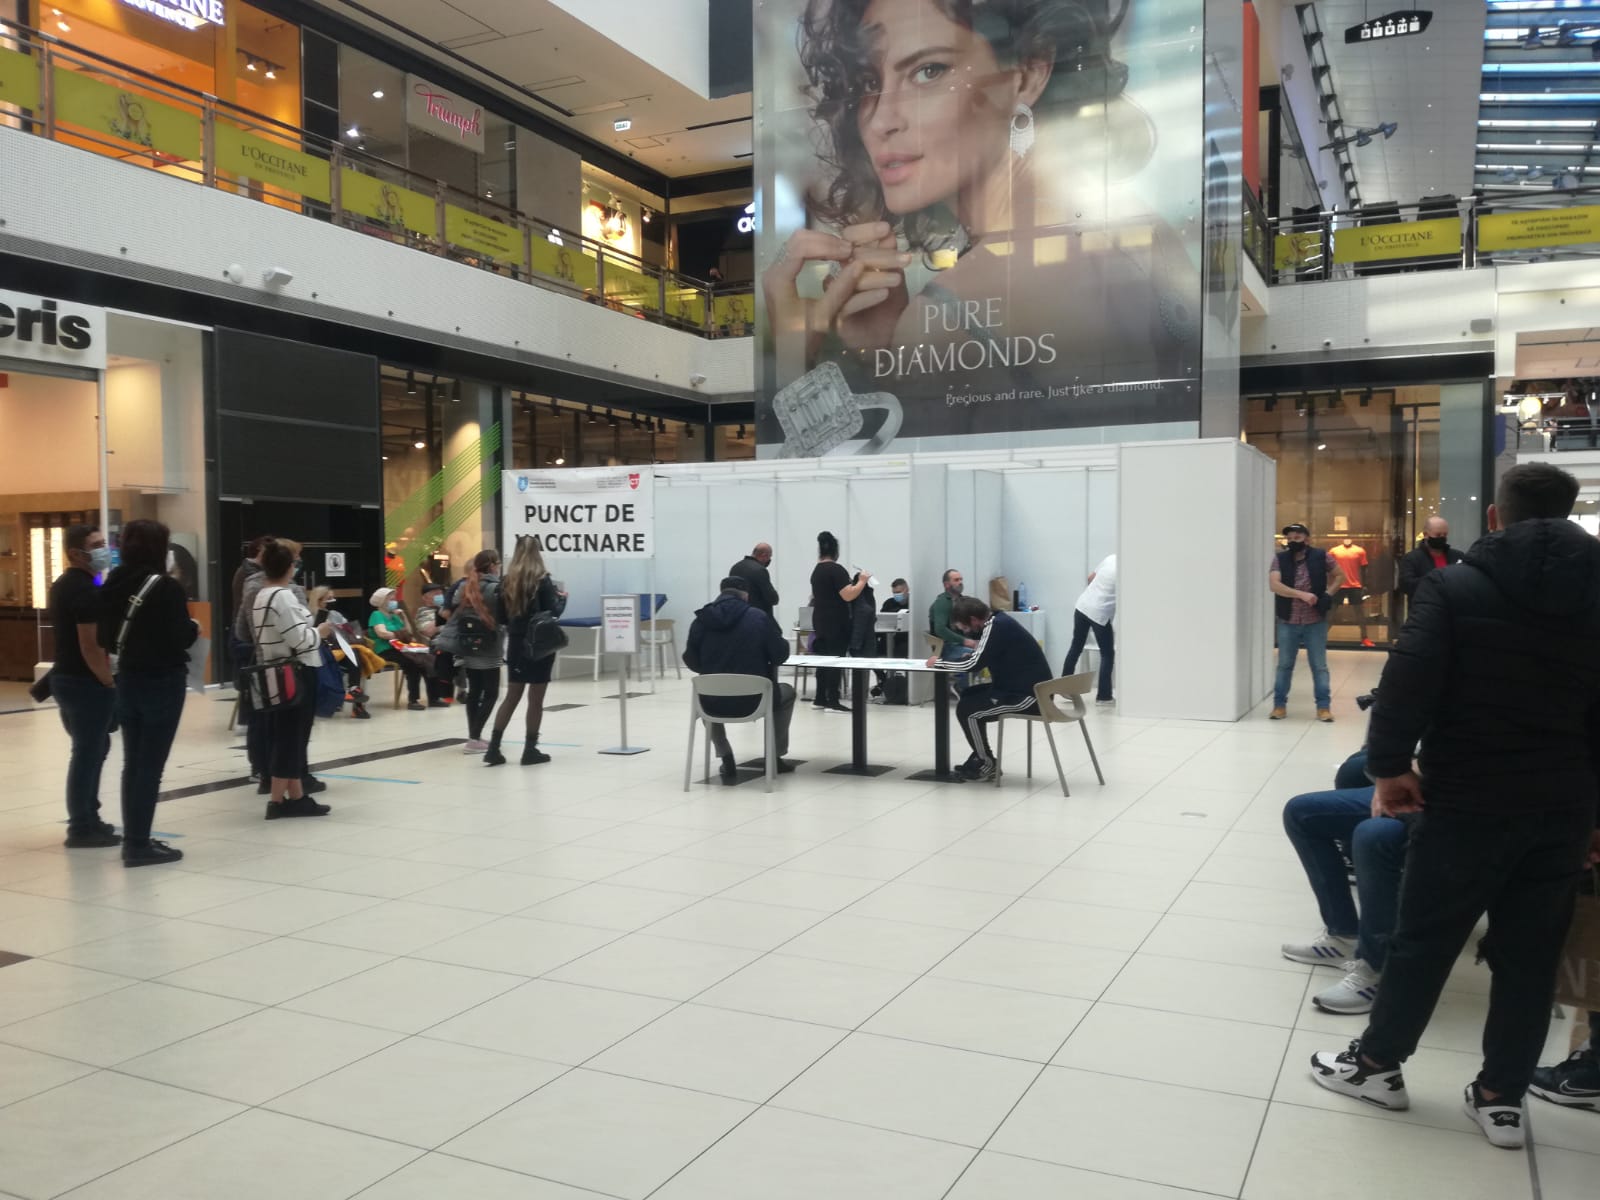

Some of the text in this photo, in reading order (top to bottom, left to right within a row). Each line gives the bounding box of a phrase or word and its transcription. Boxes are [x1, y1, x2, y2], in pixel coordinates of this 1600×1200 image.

[414, 83, 481, 140] Triumph
[924, 297, 1003, 334] PURE
[874, 333, 1057, 377] DIAMONDS
[946, 378, 1165, 405] Precious and rare. Just like a diamond.
[524, 503, 635, 524] PUNCT DE
[515, 533, 646, 552] CCINARE
